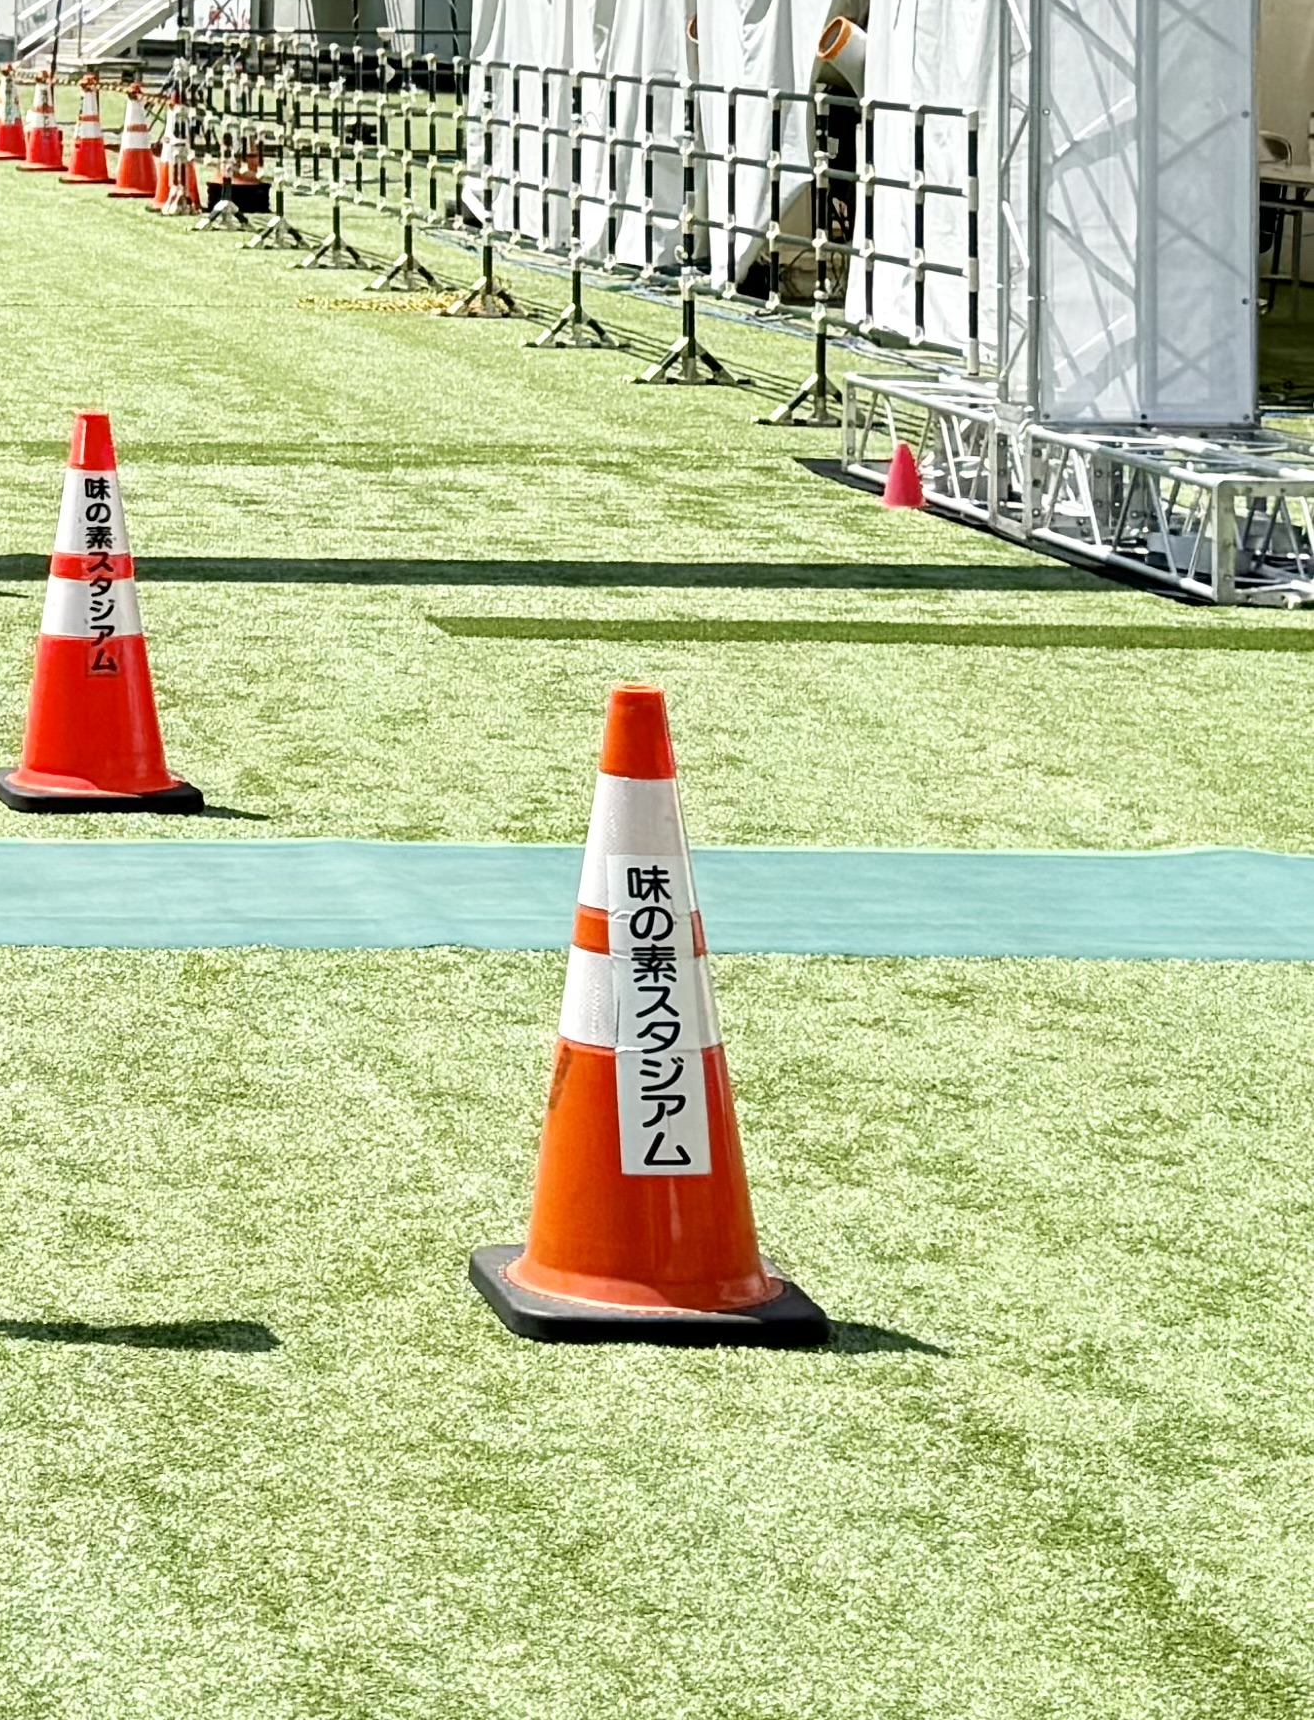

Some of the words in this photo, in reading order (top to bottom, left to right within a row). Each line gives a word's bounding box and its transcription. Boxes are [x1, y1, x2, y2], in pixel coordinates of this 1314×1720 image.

[84, 476, 118, 673] 味の素スタジアム
[626, 864, 691, 1167] 味の素スタジアム
